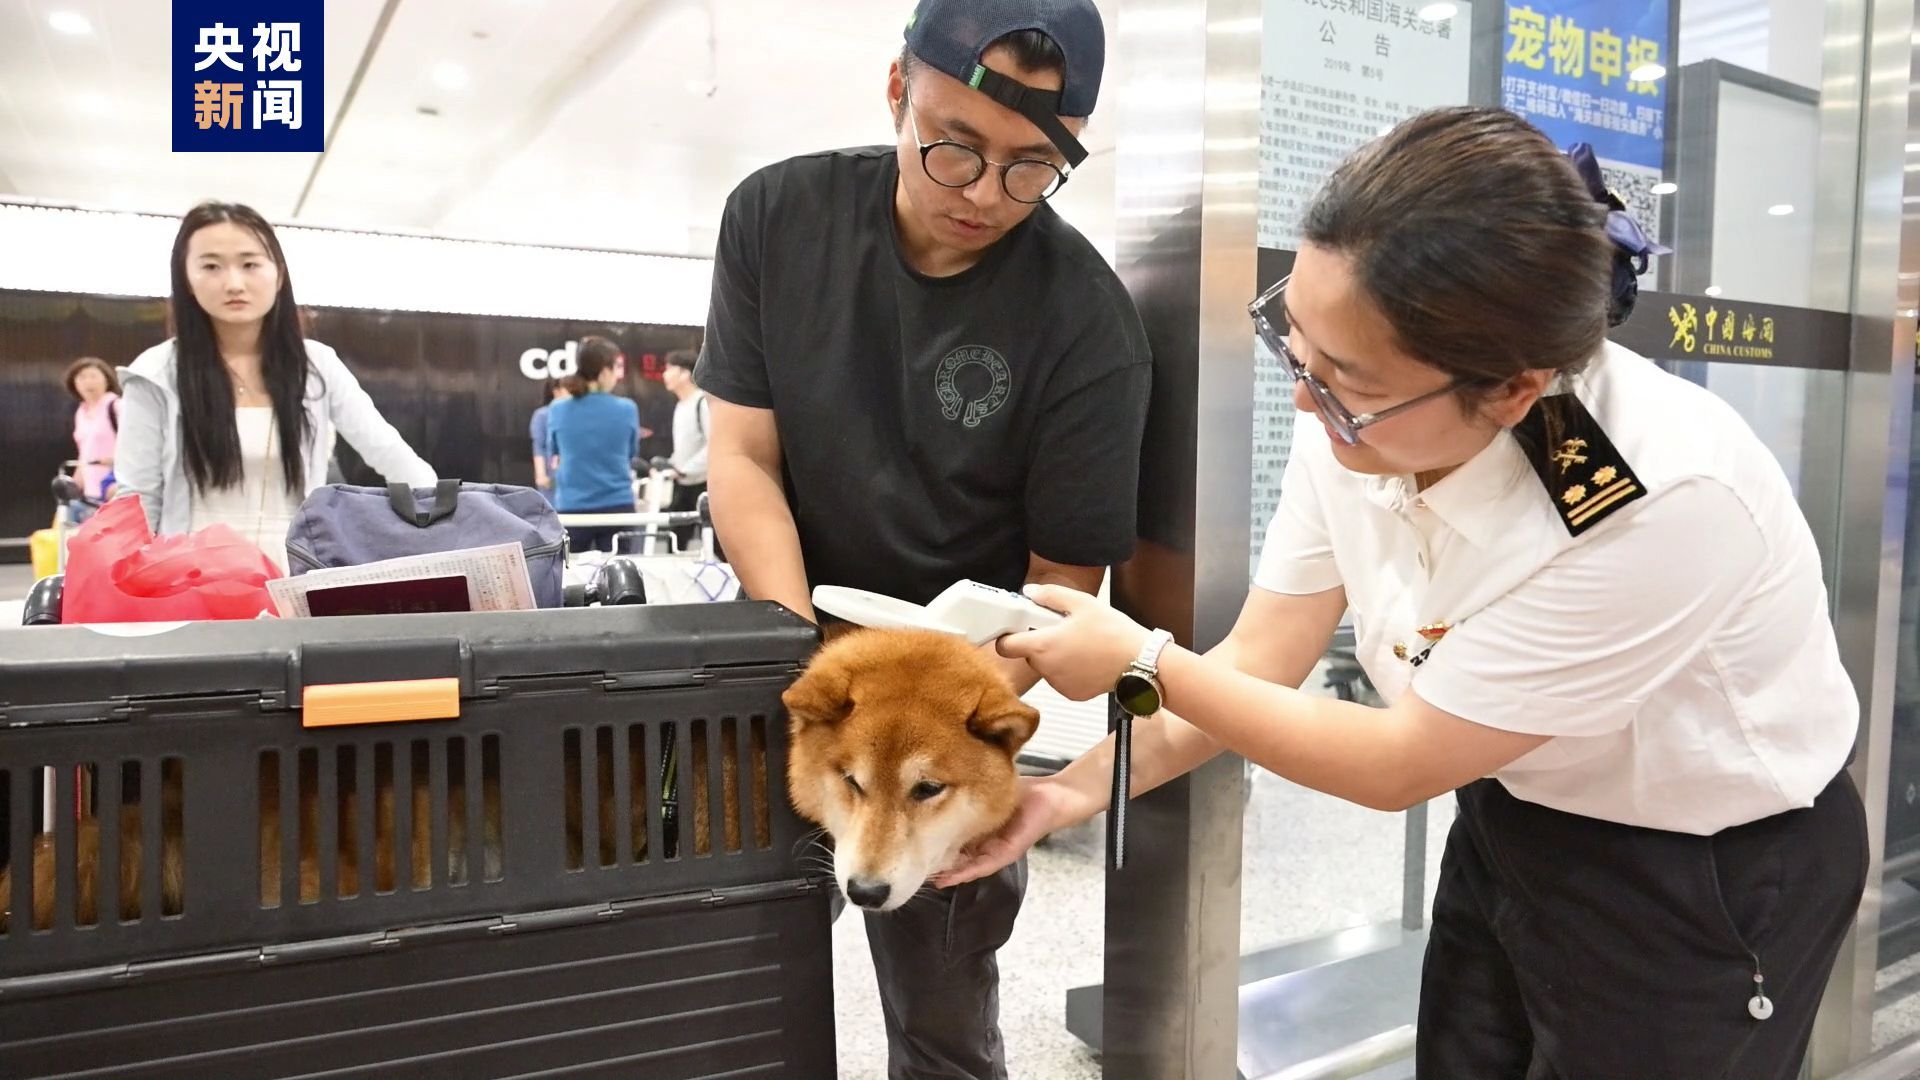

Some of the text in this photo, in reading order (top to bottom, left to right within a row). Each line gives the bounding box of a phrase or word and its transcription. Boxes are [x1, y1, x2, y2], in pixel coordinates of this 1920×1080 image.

[1319, 20, 1391, 58] 公 告
[1505, 6, 1660, 97] 宠物申报
[1703, 343, 1773, 358] CHINA CUSTOMS
[1410, 645, 1434, 667] 27
